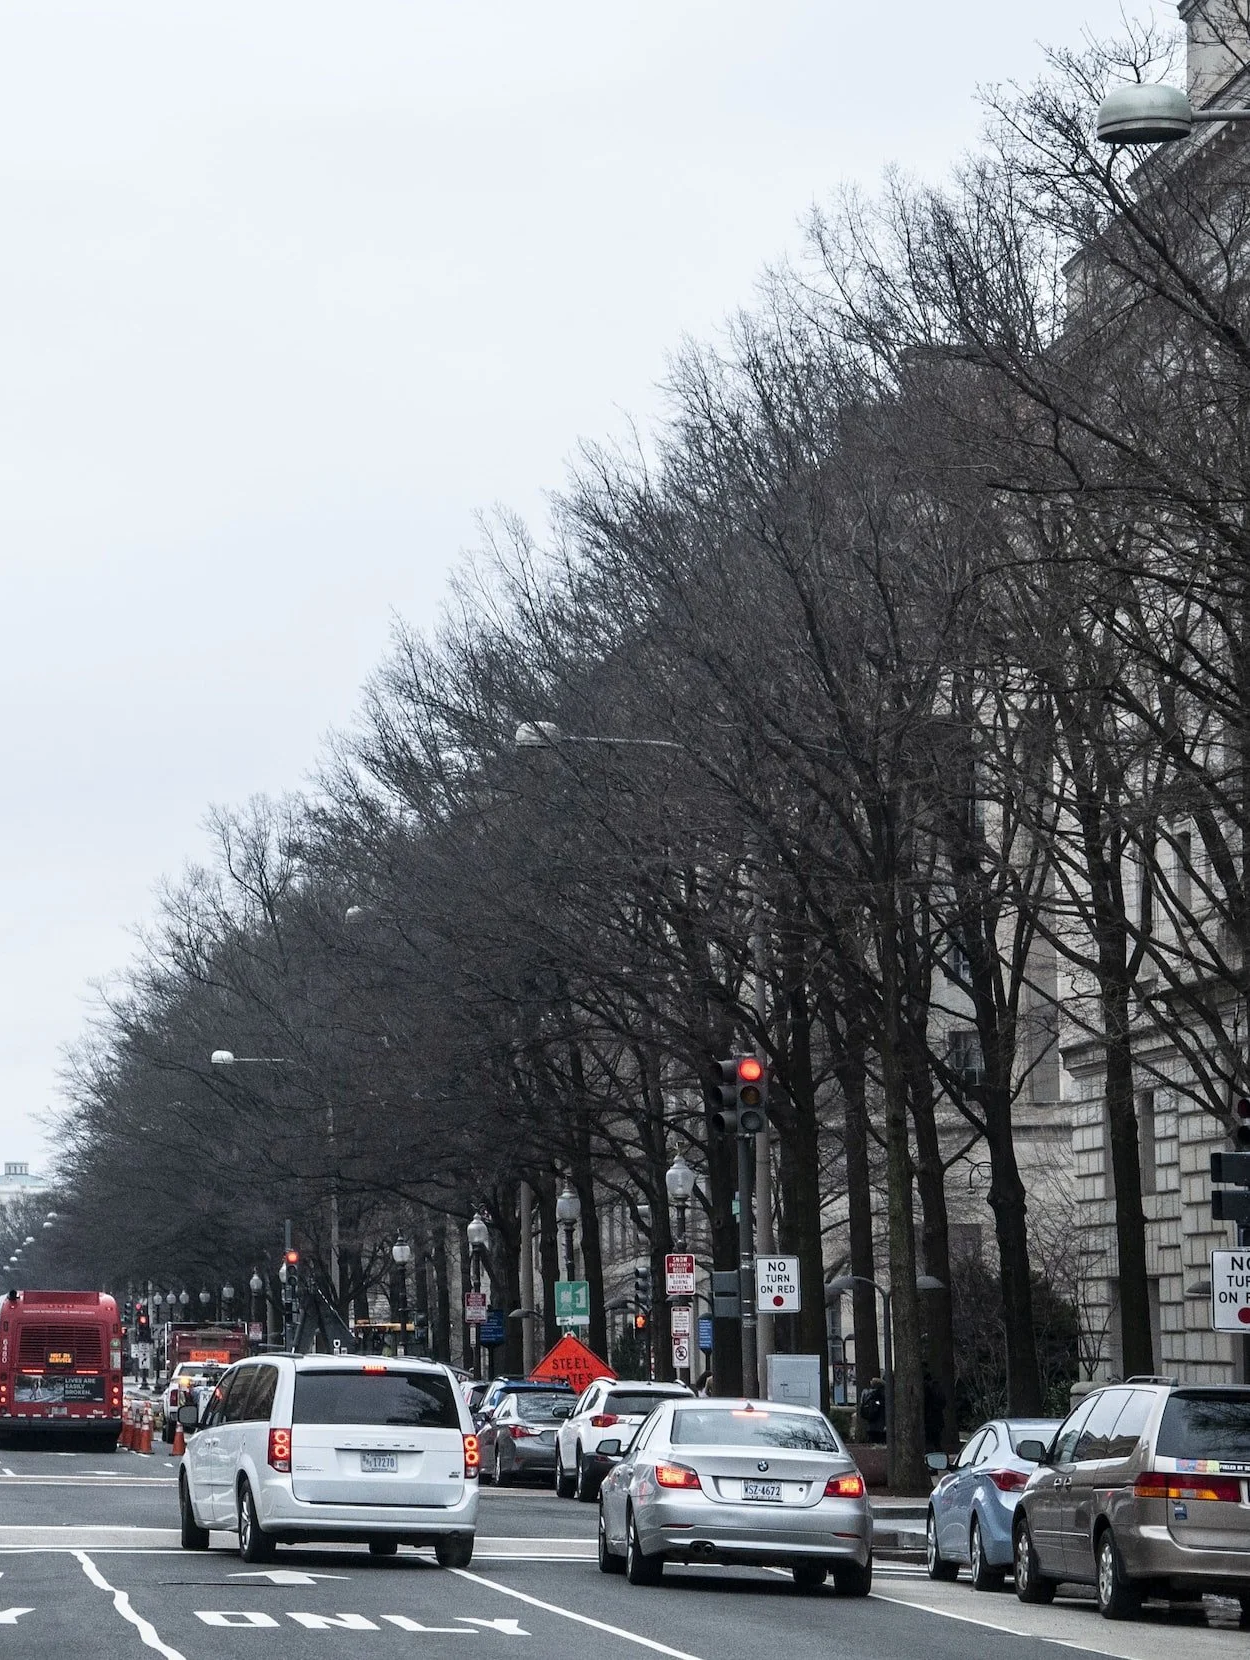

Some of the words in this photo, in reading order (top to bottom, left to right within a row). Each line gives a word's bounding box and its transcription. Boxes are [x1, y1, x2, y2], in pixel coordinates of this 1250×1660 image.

[768, 1261, 787, 1272] NO
[1231, 1256, 1250, 1271] N
[765, 1274, 790, 1283] TURN
[760, 1285, 773, 1294] ON
[777, 1285, 796, 1294] RED
[1218, 1291, 1238, 1304] ON
[1, 1339, 9, 1363] 6480
[552, 1358, 589, 1370] STEEL
[551, 1373, 594, 1385] PATES
[193, 1611, 532, 1636] ONLY
